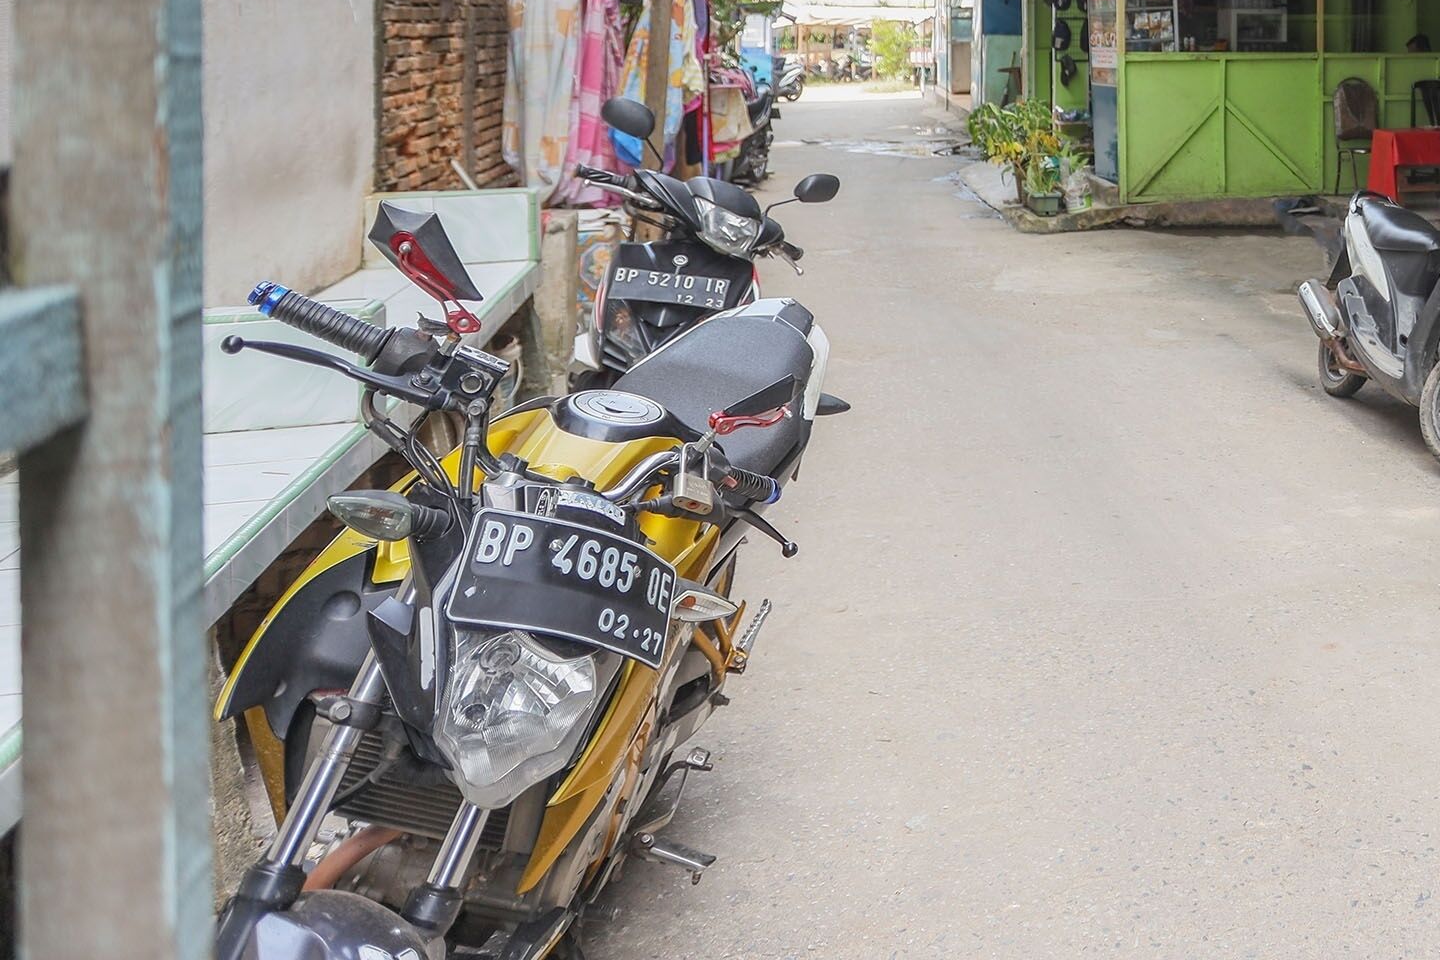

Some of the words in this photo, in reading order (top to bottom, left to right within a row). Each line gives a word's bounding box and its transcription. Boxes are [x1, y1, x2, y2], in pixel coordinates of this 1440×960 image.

[614, 267, 639, 283] BP
[647, 271, 695, 290] 5210
[705, 278, 726, 294] IR
[676, 294, 694, 304] 12
[705, 298, 724, 308] 23
[476, 520, 534, 566] BP
[551, 534, 639, 593] 4685
